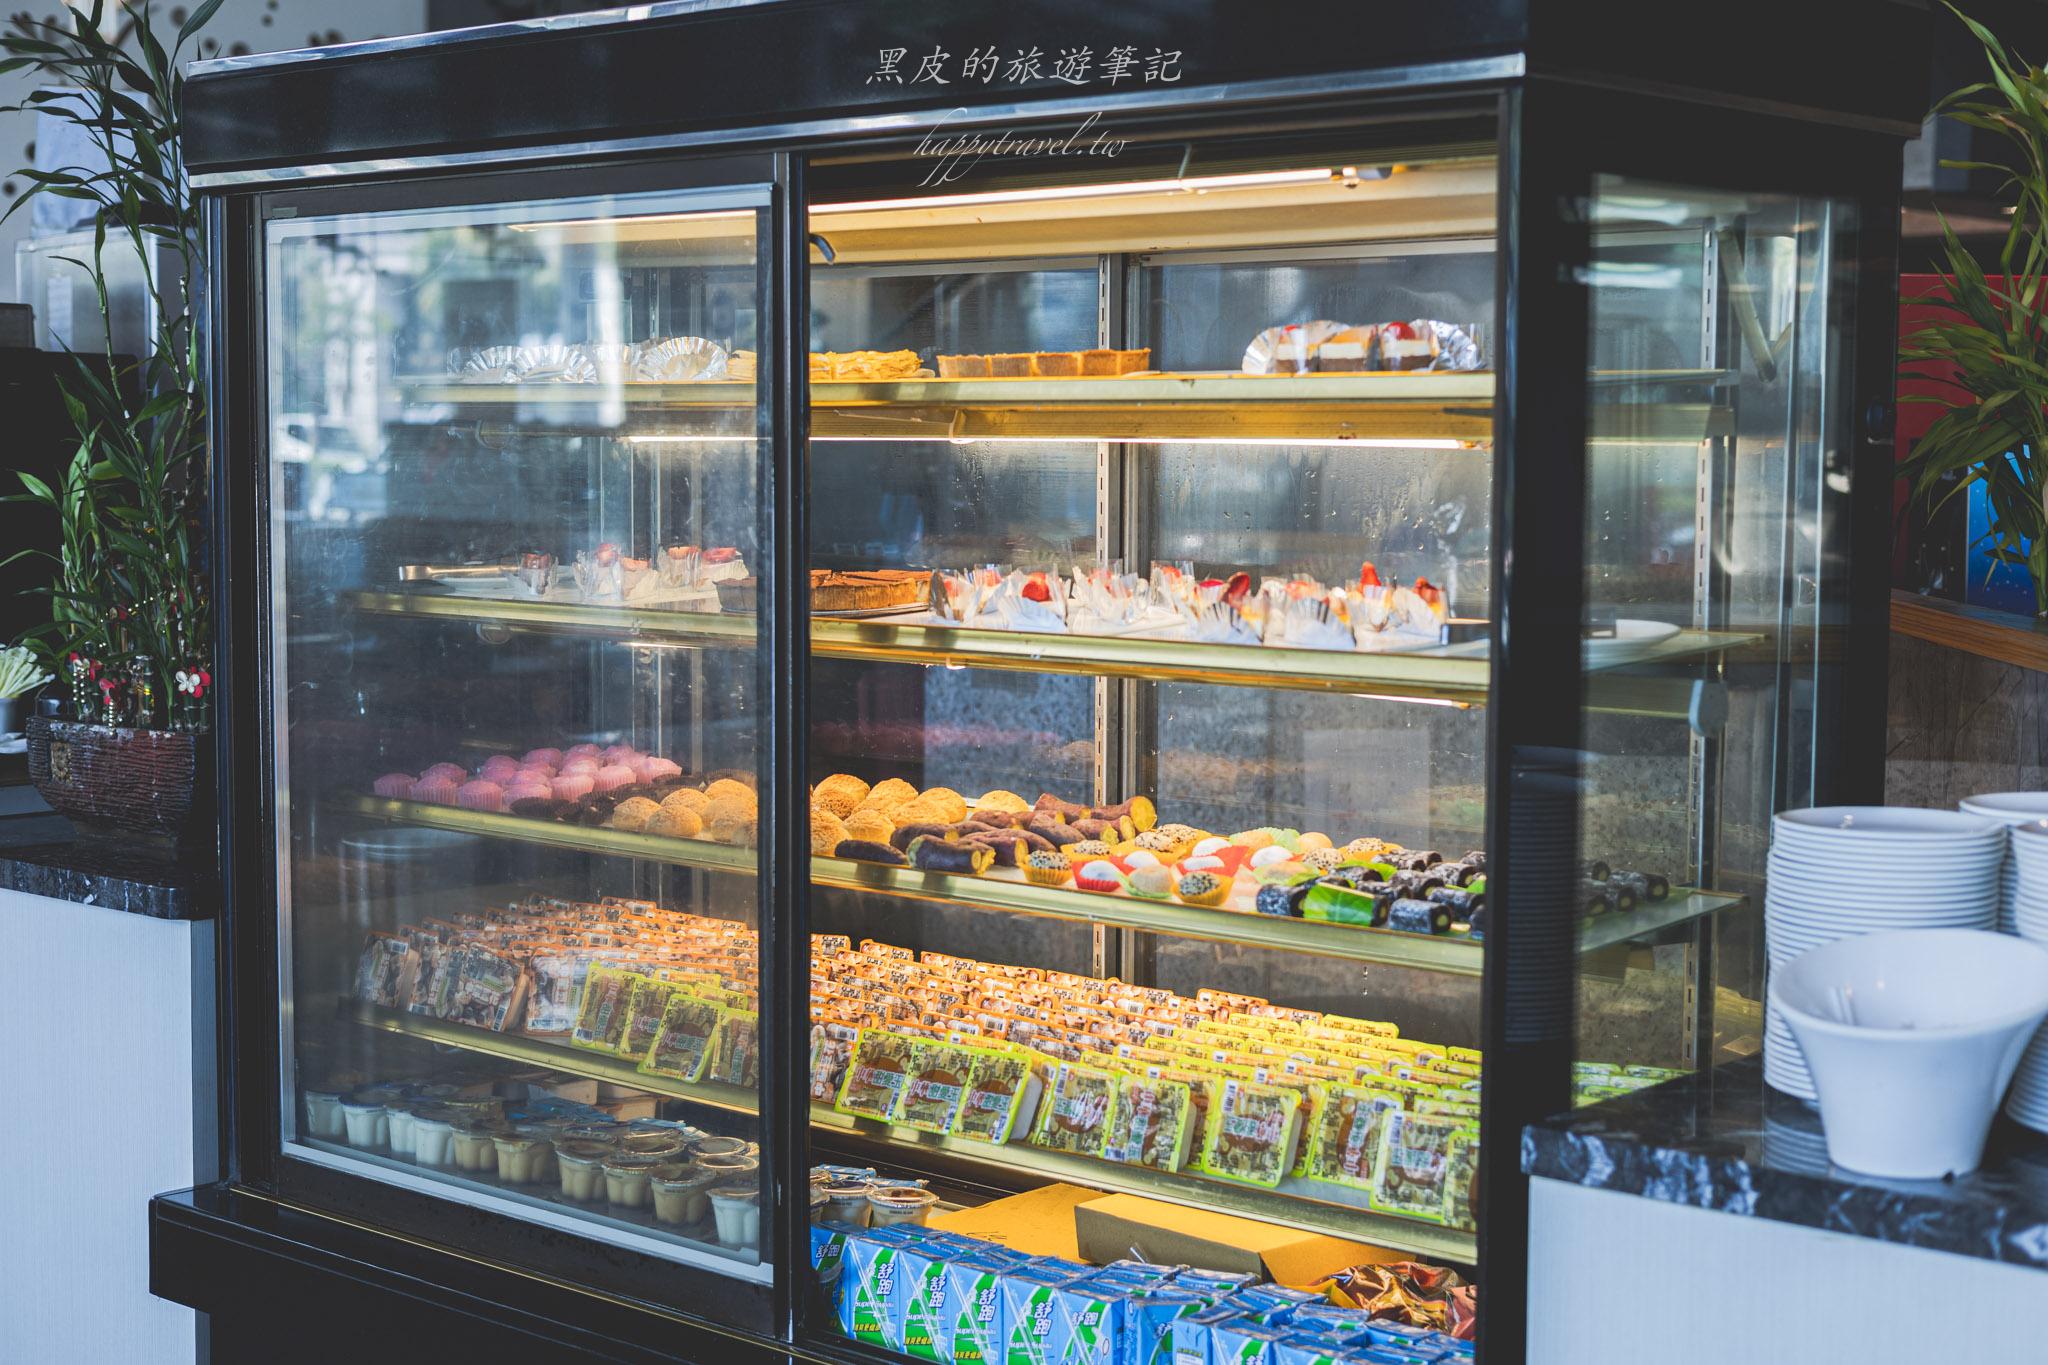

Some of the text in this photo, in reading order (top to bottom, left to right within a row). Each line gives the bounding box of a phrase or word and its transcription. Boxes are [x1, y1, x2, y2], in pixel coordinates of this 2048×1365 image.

[877, 1263, 895, 1295] 舒跑
[928, 1275, 947, 1308] 舒跑
[978, 1288, 997, 1322] 舒跑
[1032, 1300, 1054, 1336] 舒跑
